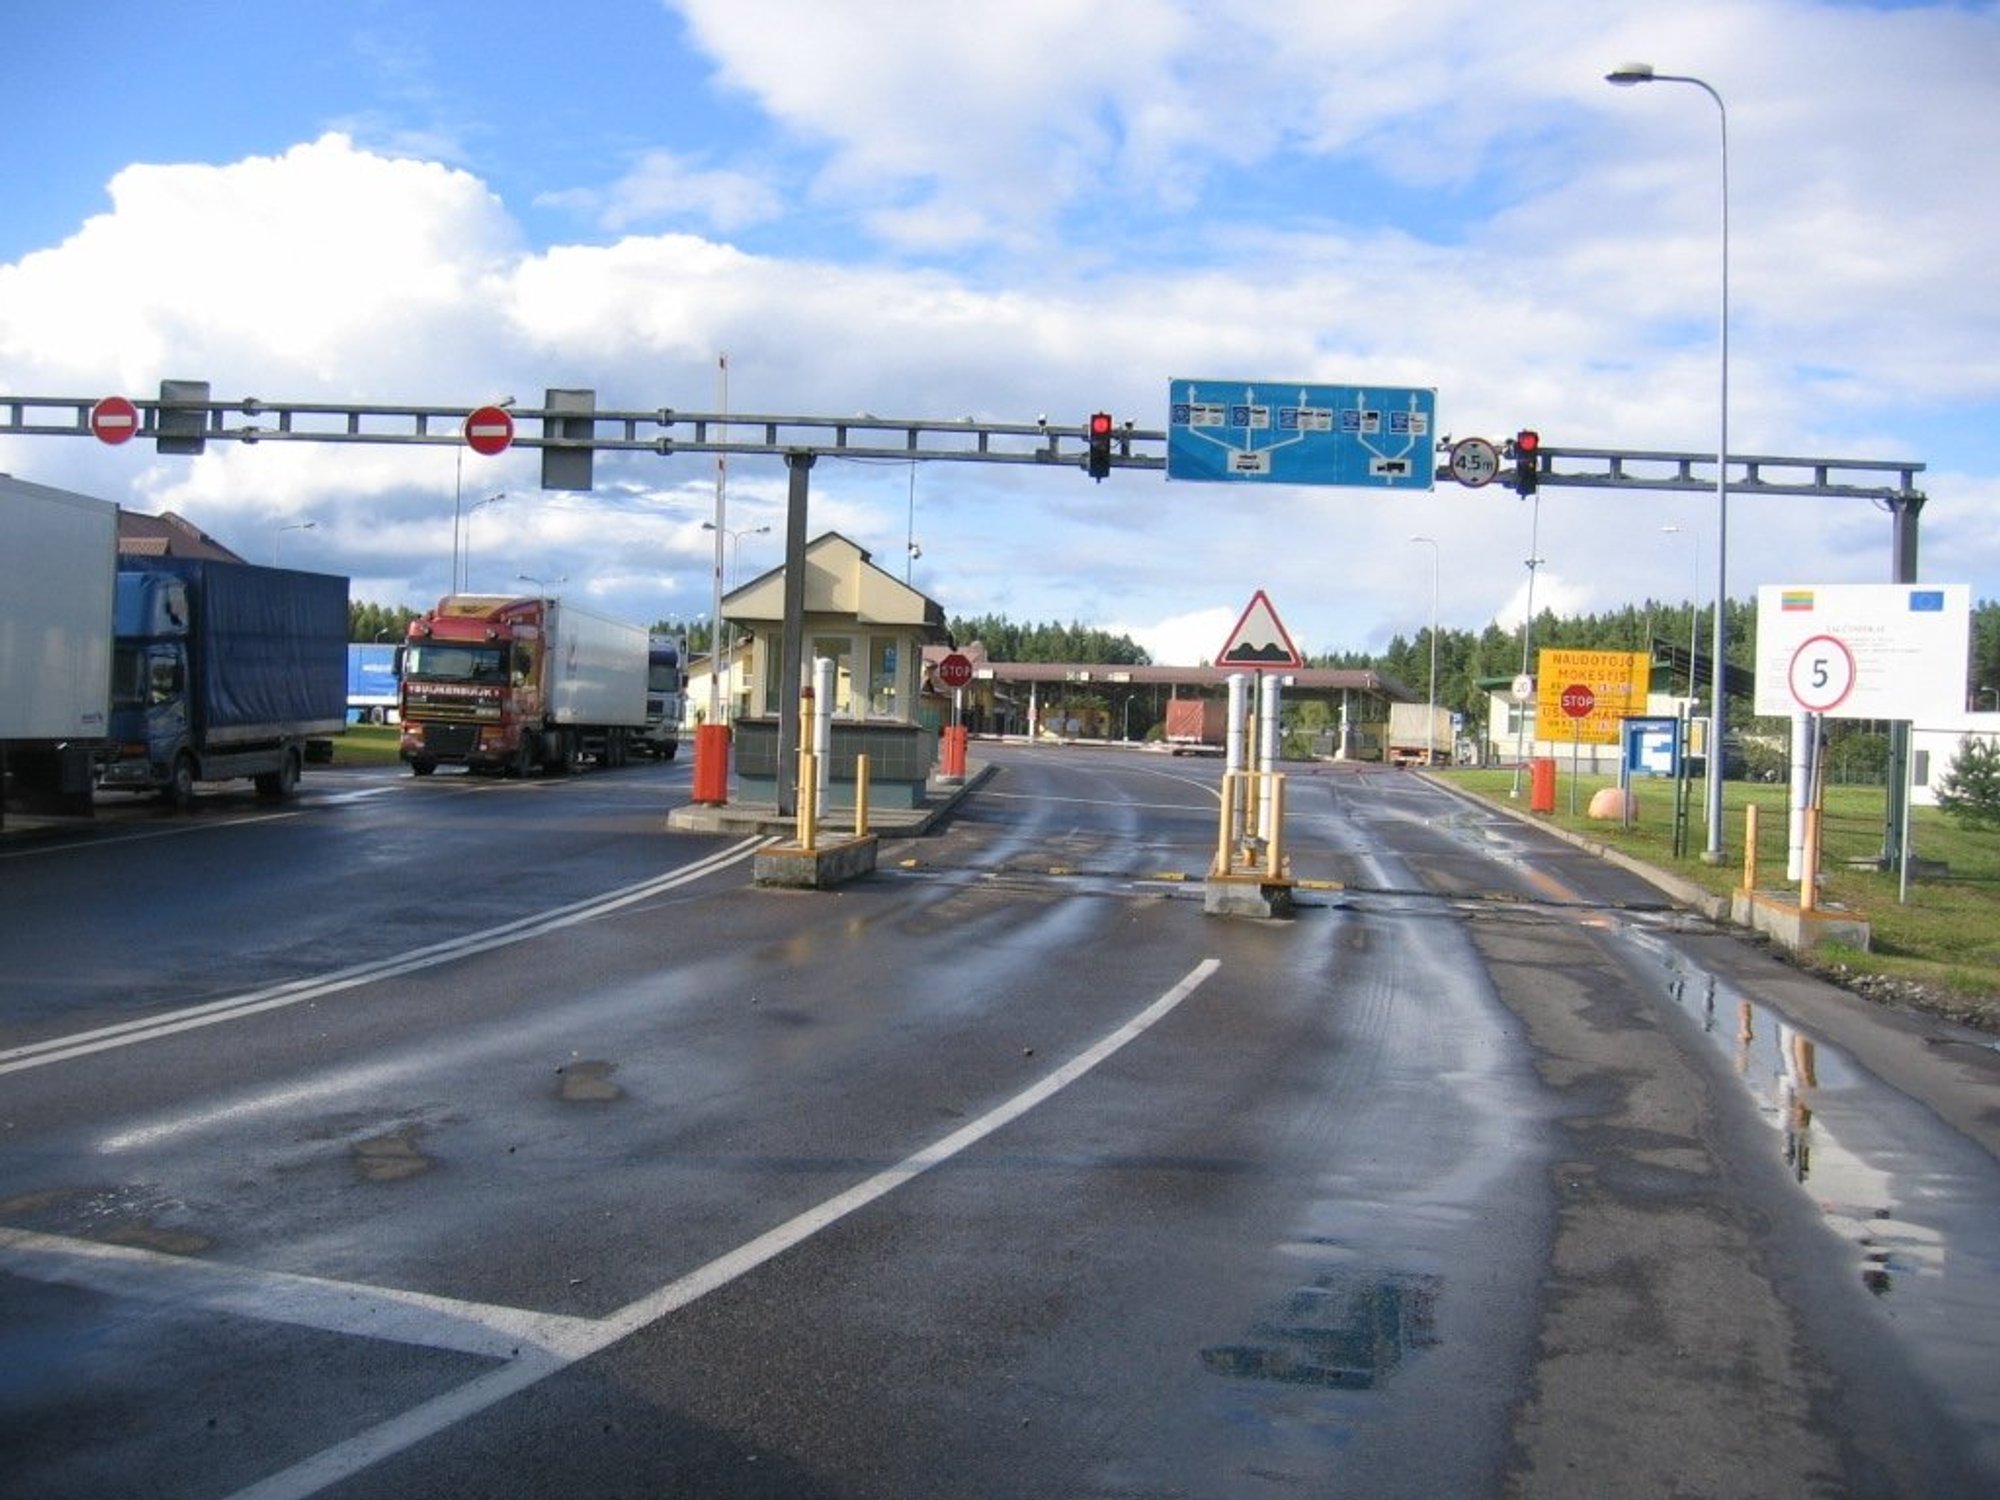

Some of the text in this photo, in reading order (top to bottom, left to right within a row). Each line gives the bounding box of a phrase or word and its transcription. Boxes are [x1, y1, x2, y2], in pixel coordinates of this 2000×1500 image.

[942, 666, 970, 677] STOP
[1558, 669, 1627, 682] MOKESTIS
[1812, 659, 1829, 688] 5
[1562, 695, 1594, 707] STOP
